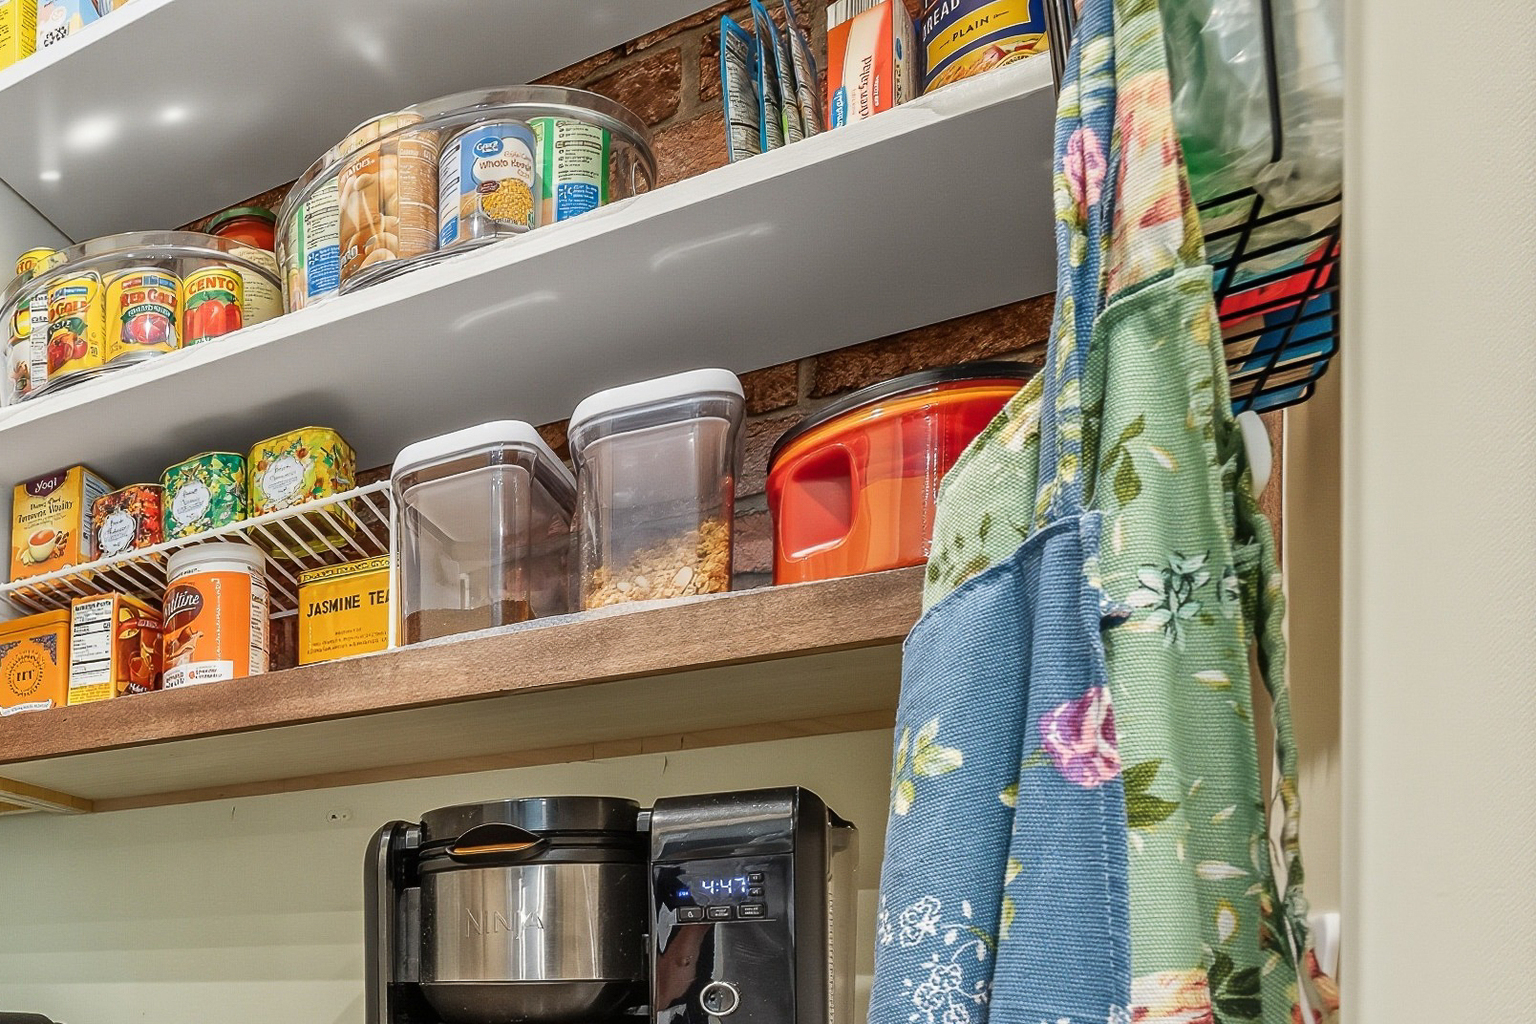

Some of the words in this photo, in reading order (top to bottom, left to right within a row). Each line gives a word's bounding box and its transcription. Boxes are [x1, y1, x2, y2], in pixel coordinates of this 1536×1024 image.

[952, 15, 989, 42] PLAIN
[189, 276, 236, 296] CENTO
[34, 477, 57, 493] yogi
[306, 594, 361, 617] JASMINE
[702, 877, 745, 895] 4:47
